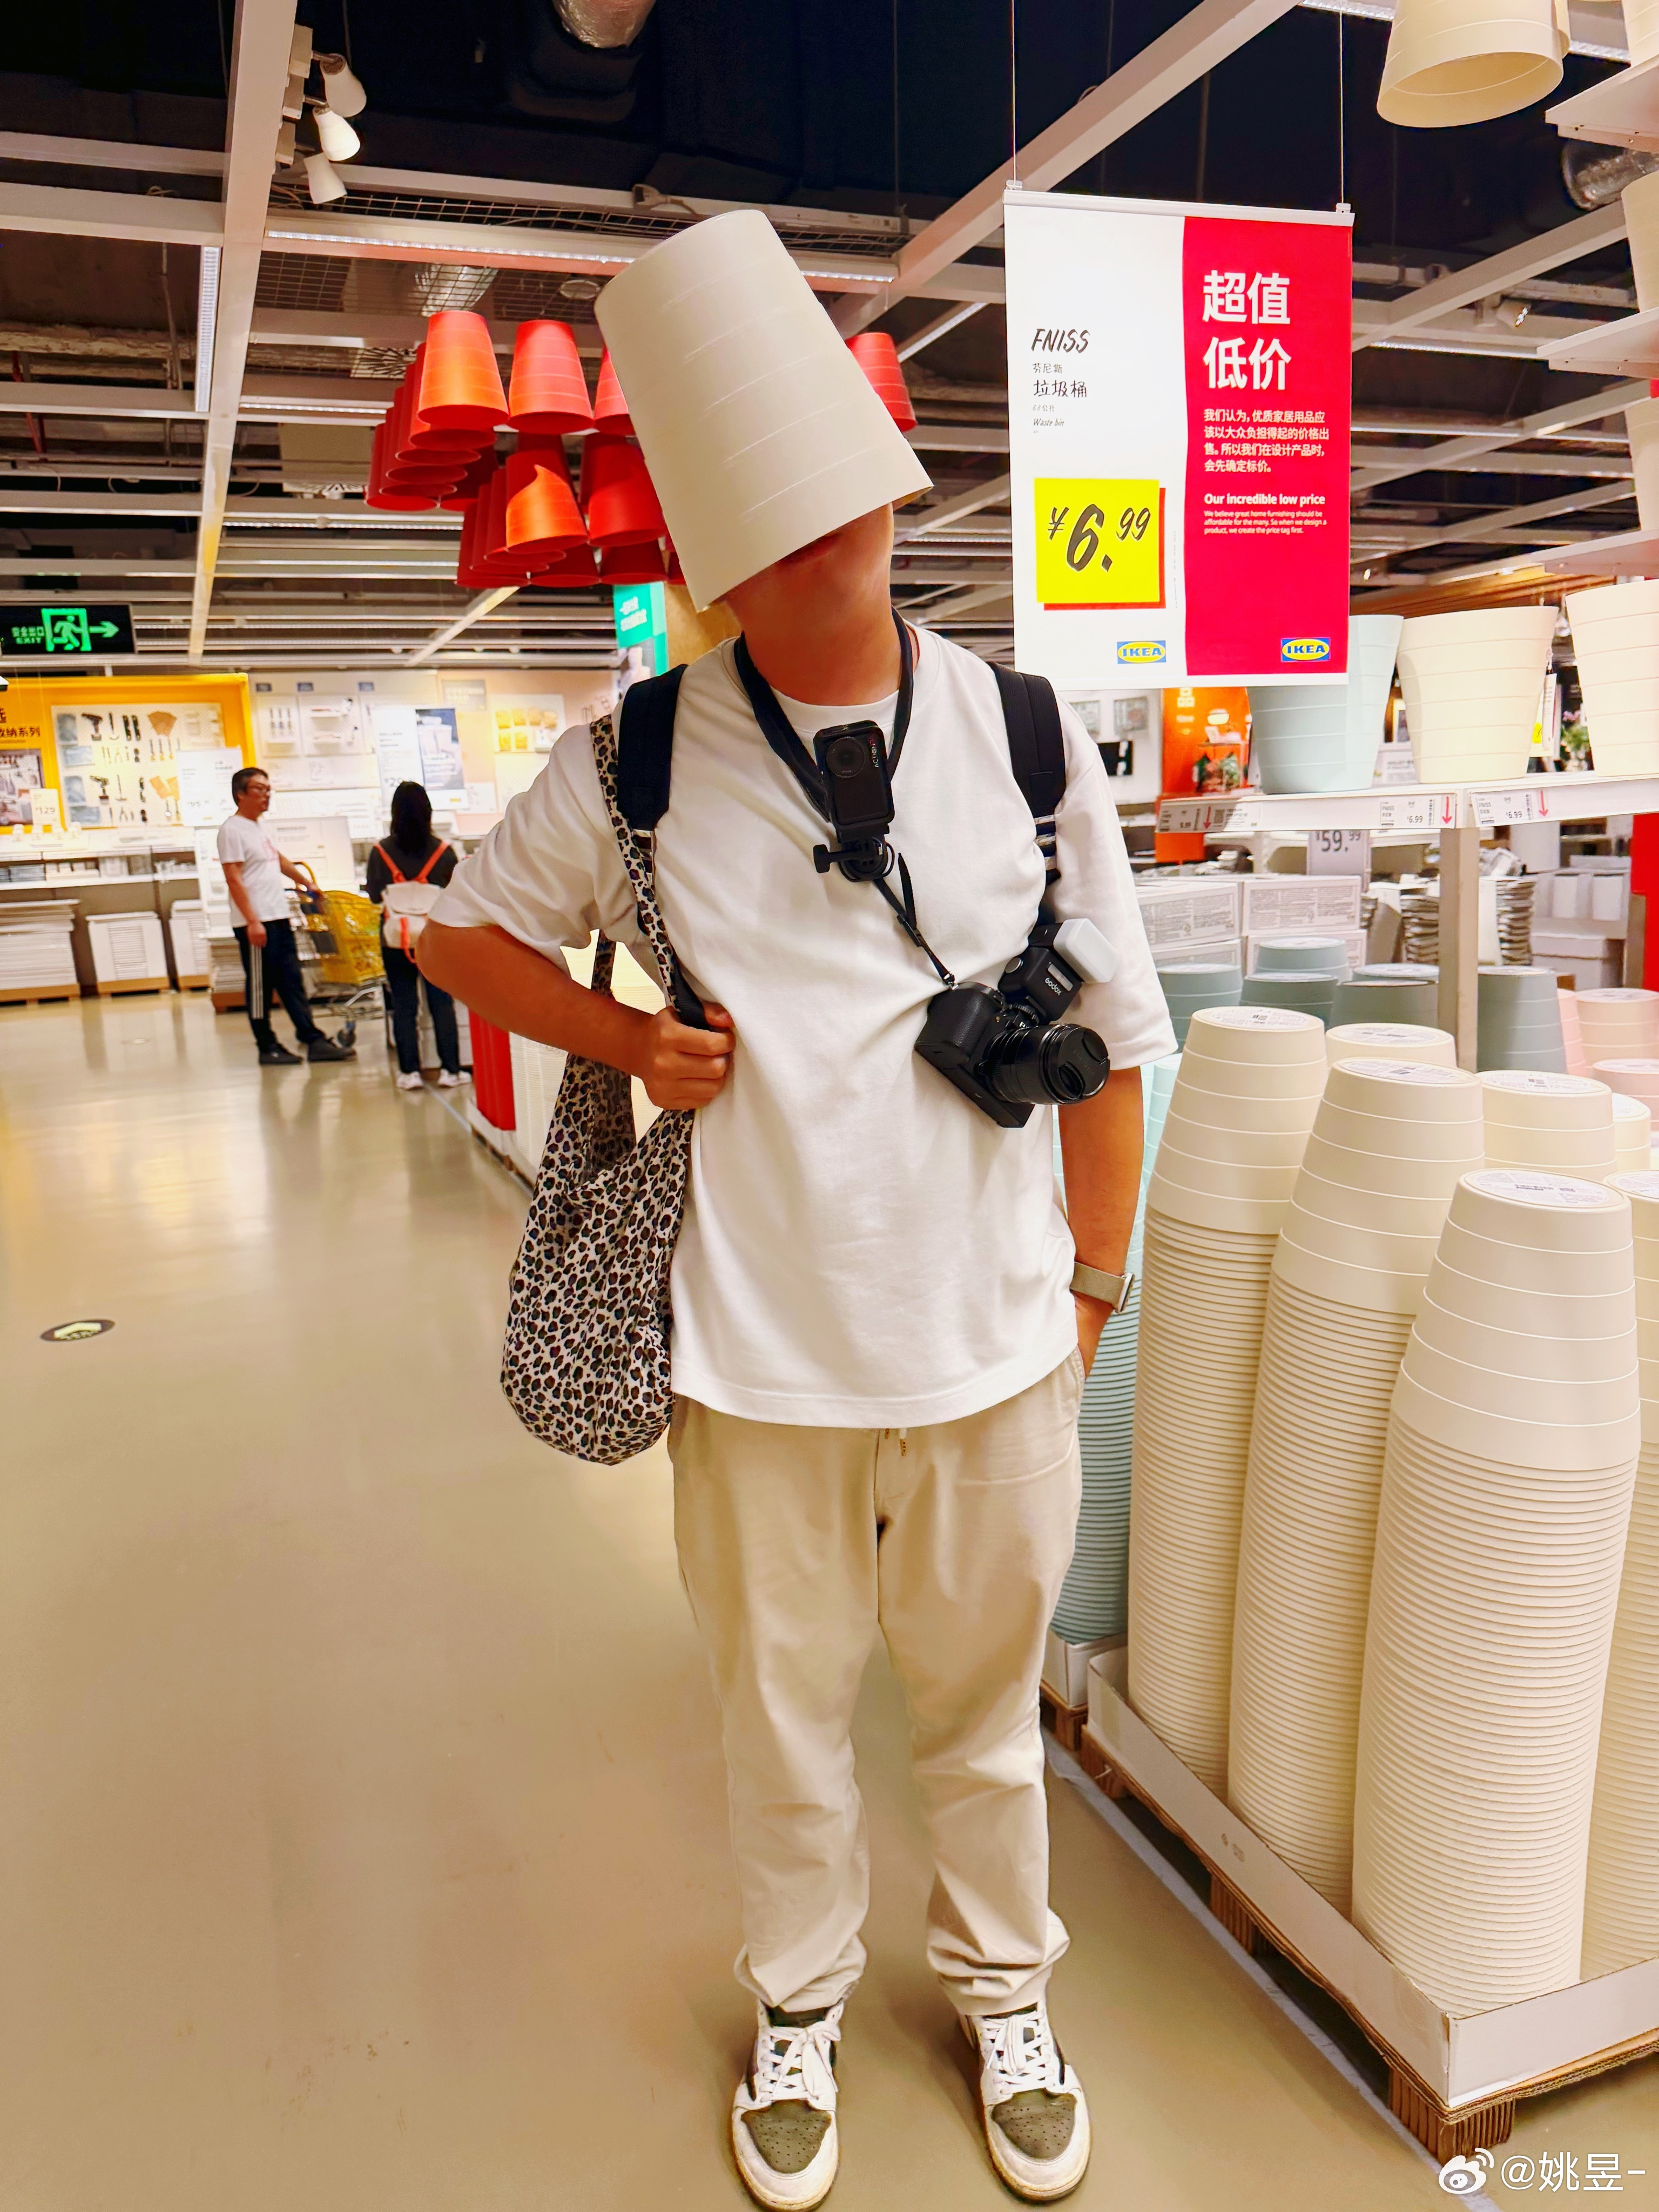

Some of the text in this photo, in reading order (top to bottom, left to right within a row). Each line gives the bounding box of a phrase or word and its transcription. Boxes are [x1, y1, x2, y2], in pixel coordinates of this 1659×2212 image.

[1203, 270, 1291, 325] 超值
[1031, 328, 1090, 354] FNISS
[1032, 362, 1063, 374] 芬尼斯
[1203, 337, 1292, 390] 低价
[1033, 379, 1087, 398] 垃圾桶
[1033, 418, 1064, 427] Waste bin
[1204, 426, 1330, 440] 该以大众负担得起的价格出
[1204, 459, 1272, 473] 会先确定标价。
[1204, 493, 1326, 508] Our incredible low price
[1235, 511, 1250, 519] great
[1267, 510, 1296, 519] furnishing
[1303, 519, 1323, 527] design
[1048, 503, 1151, 572] ¥6.99
[1266, 527, 1280, 535] price
[1122, 646, 1162, 657] IKEA
[1286, 644, 1326, 655] IKEA
[1045, 977, 1062, 996] Godox
